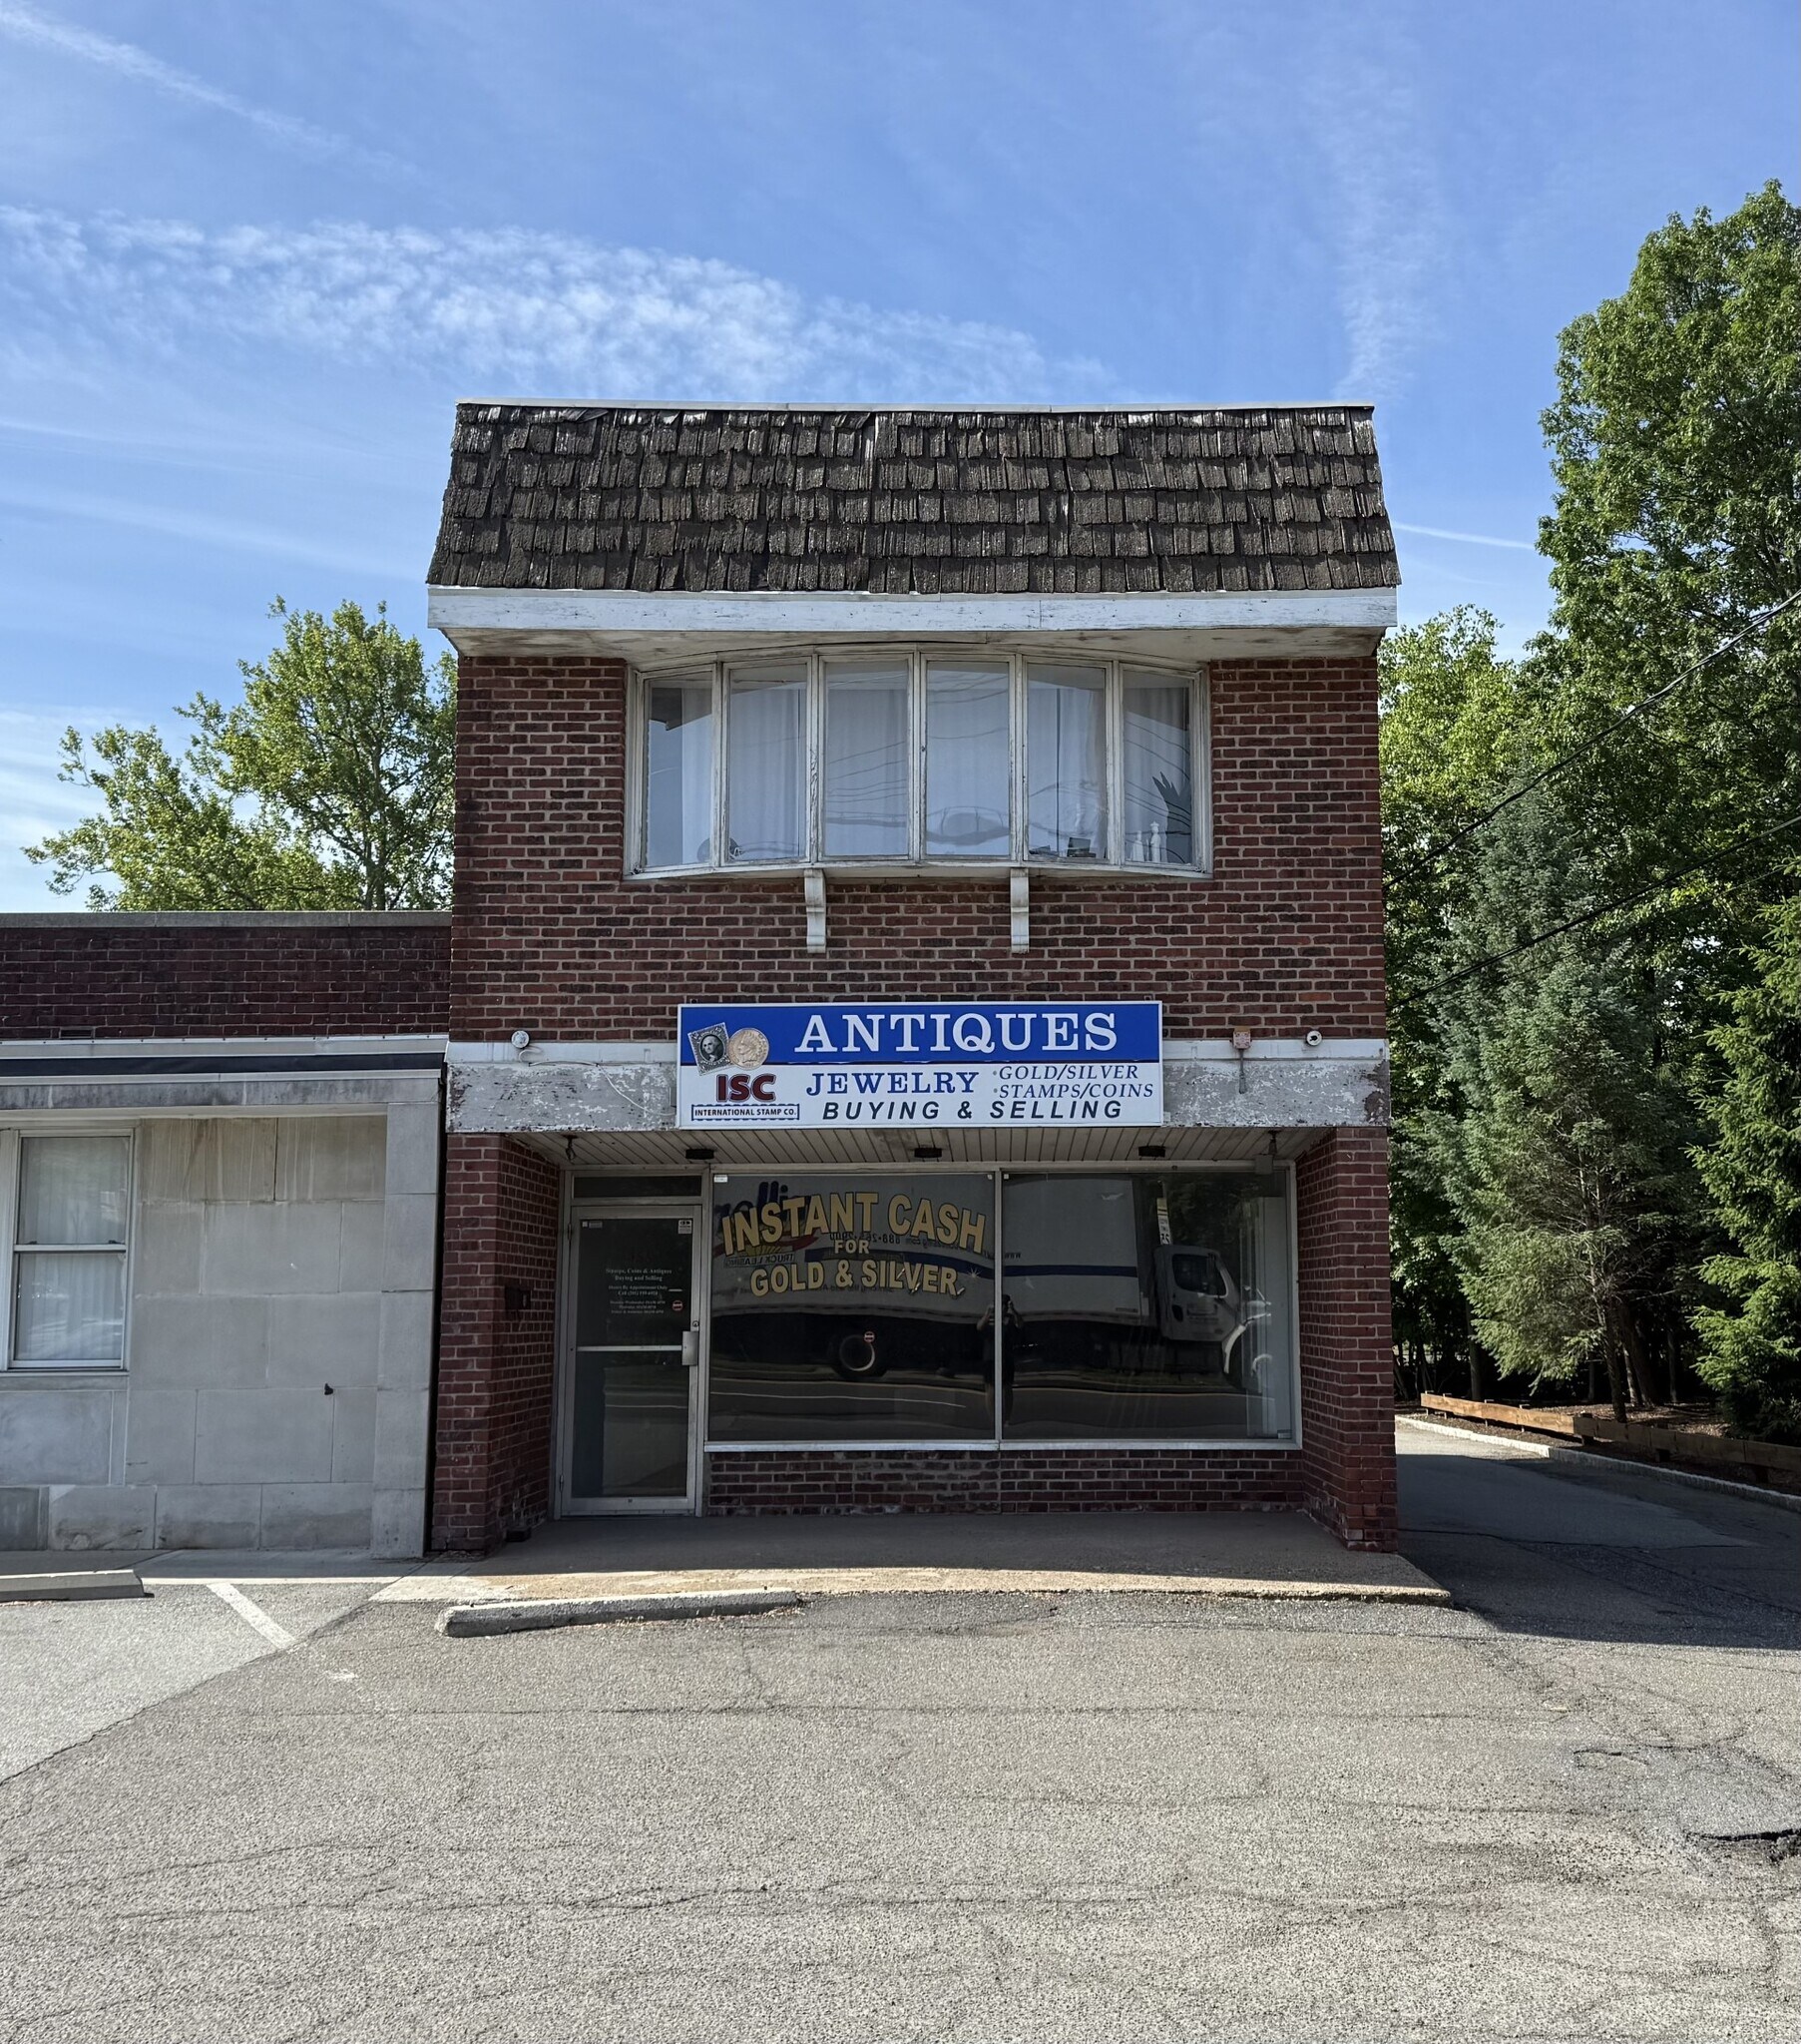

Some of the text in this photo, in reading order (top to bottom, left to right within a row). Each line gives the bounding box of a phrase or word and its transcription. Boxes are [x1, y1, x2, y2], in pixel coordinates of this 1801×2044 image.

[794, 1012, 1118, 1054] ANTIQUES
[806, 1071, 979, 1096] JEWELRY
[999, 1064, 1138, 1081] GOLD/SILVER
[715, 1073, 777, 1103] ISC
[999, 1083, 1153, 1099] STAMPS/COINS
[694, 1108, 755, 1117] INTERNATIONAL
[822, 1100, 1123, 1120] BUYING & SELLING
[721, 1192, 880, 1258] INSTANT
[888, 1194, 987, 1255] CASH
[834, 1239, 870, 1256] FOR
[750, 1262, 826, 1297] GOLD
[835, 1258, 853, 1288] &
[860, 1259, 959, 1296] SILVER
